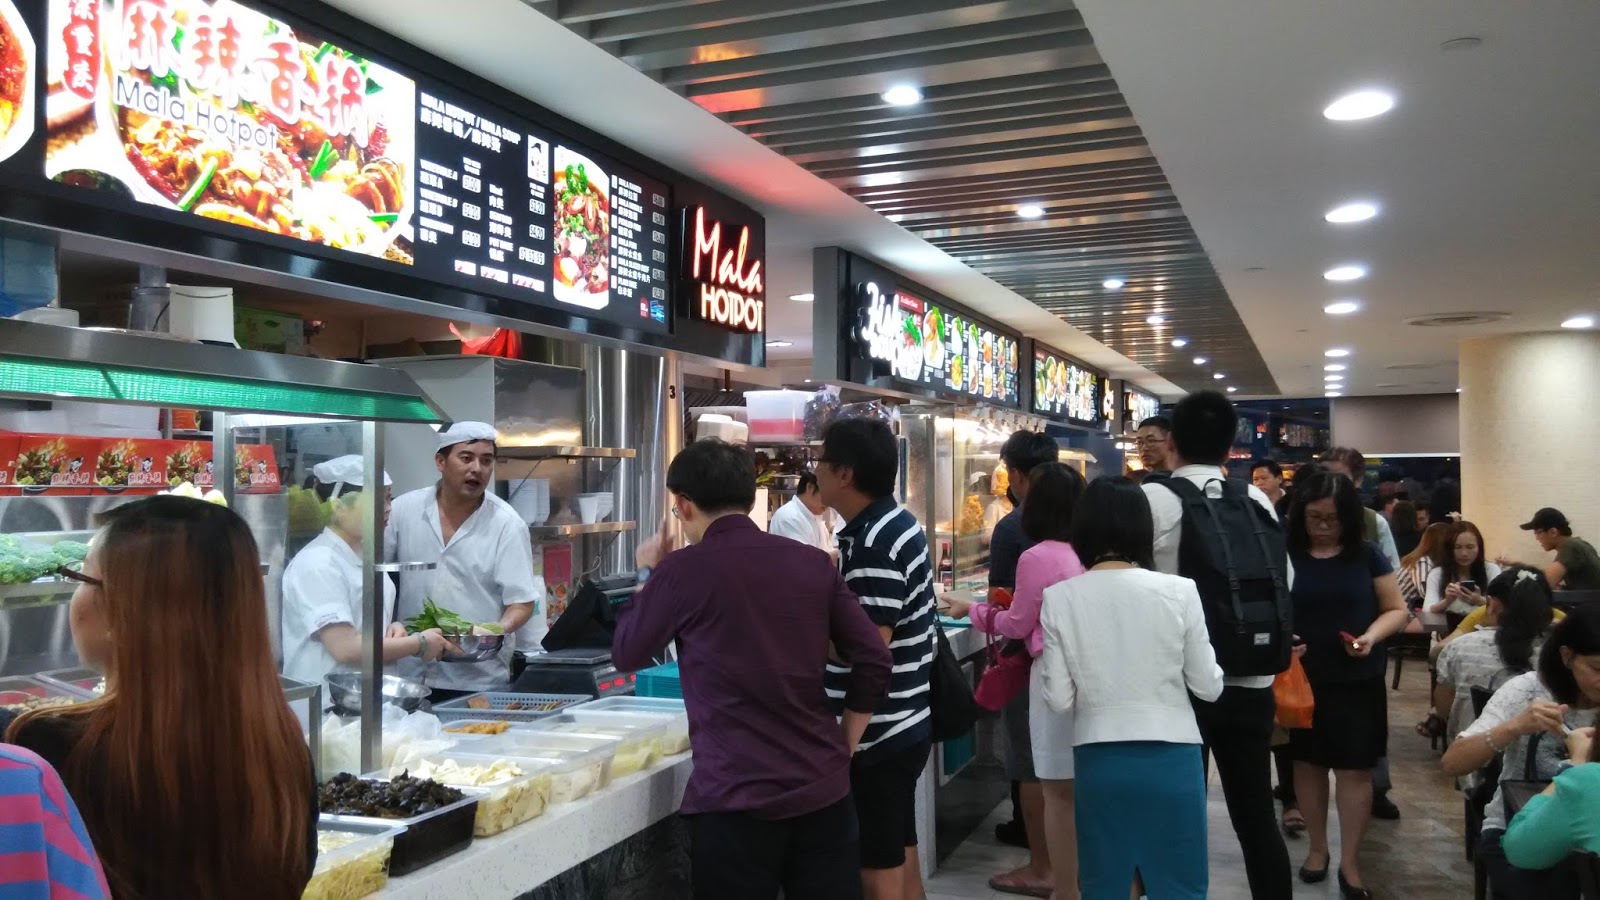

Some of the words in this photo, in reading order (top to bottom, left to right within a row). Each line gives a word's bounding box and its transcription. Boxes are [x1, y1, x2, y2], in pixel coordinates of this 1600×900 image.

[116, 75, 186, 121] Mala
[196, 104, 277, 148] Hotpot
[693, 204, 763, 293] Mala
[702, 283, 763, 332] HOTPOT
[669, 384, 676, 399] 3
